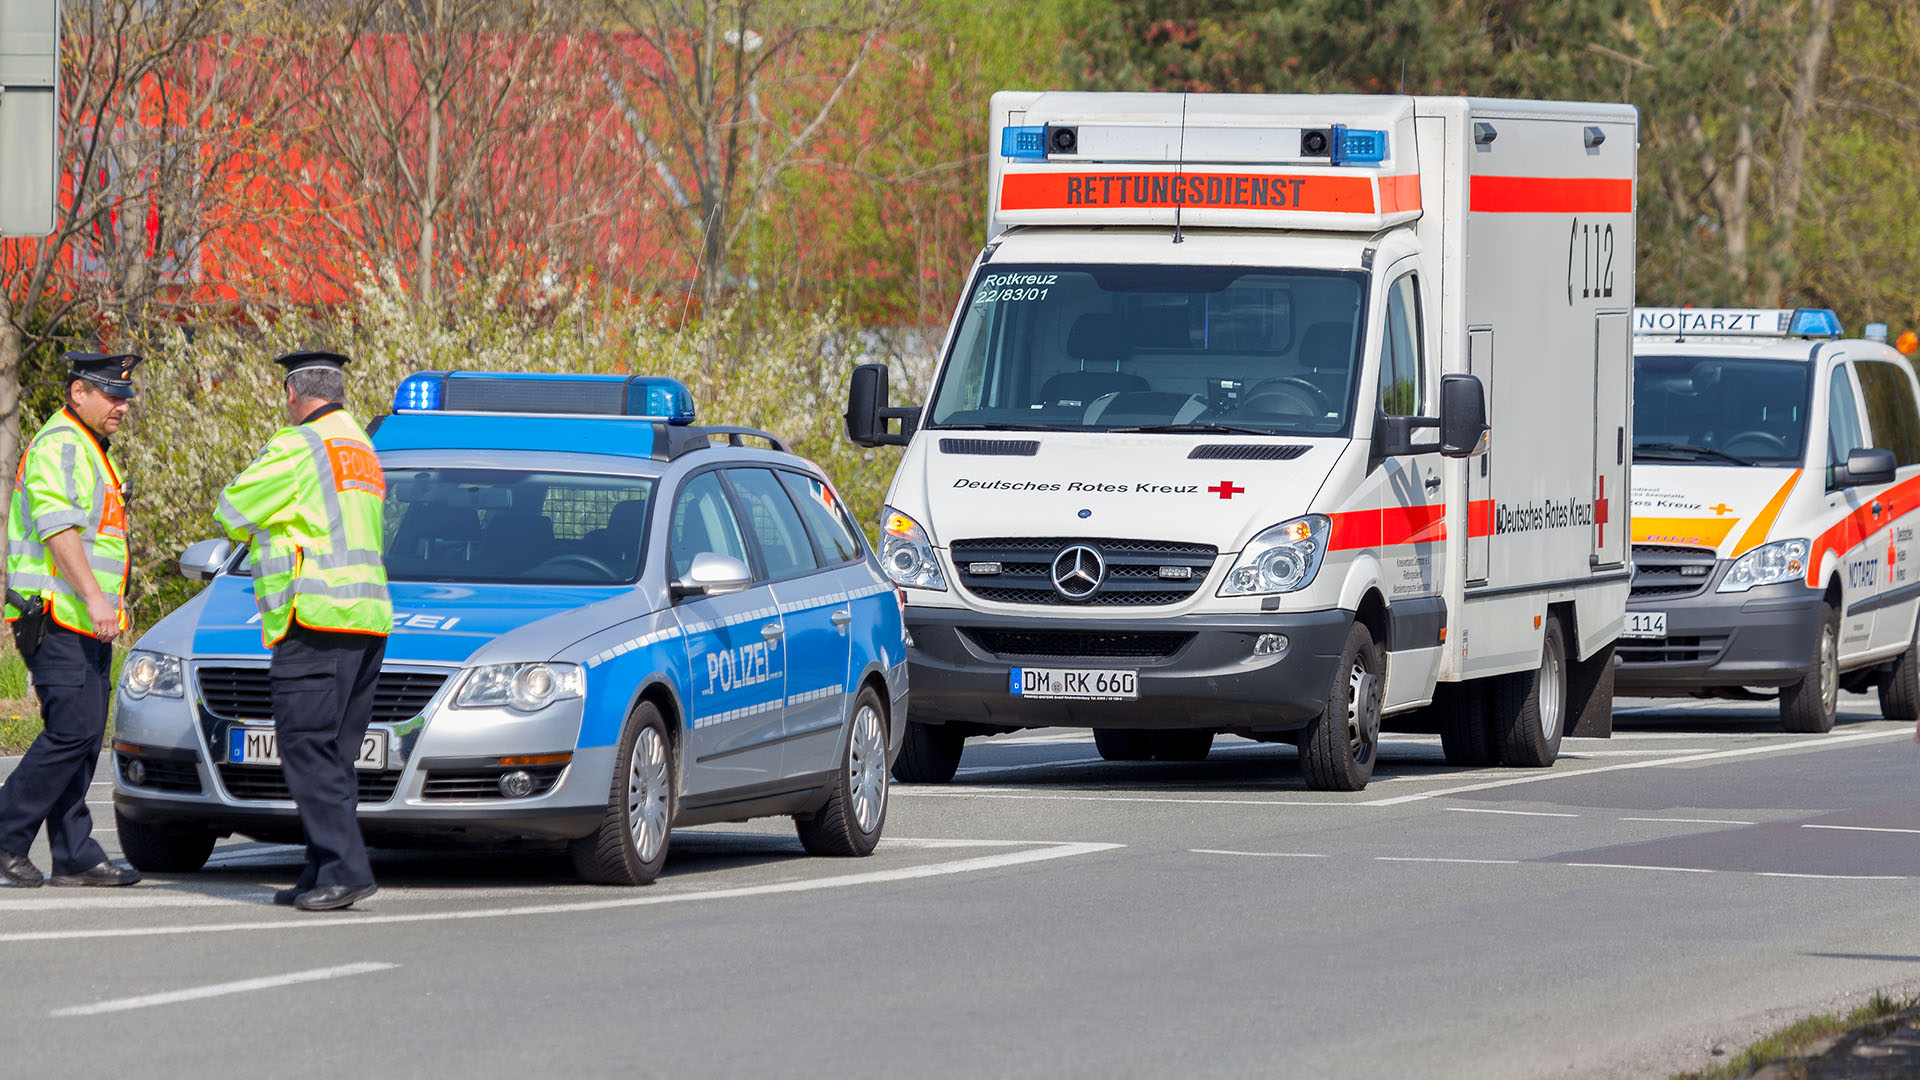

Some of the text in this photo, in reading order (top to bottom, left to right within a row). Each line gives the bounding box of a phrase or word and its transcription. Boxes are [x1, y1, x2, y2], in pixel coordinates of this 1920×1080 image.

[1066, 175, 1306, 207] RETTUNGSDIENST
[1583, 222, 1614, 298] 112
[983, 272, 1059, 287] Rotkreuz
[975, 287, 1049, 304] 22/83/01
[1639, 313, 1761, 331] NOTARZT
[952, 478, 1199, 494] Deutsches Rotes Kreuz
[1501, 496, 1591, 535] Deutsches Rotes Kreuz
[1656, 500, 1702, 510] Kreuz
[1848, 558, 1878, 588] NOTARZT
[1631, 615, 1664, 632] 114
[706, 641, 769, 695] POLIZEI
[1023, 671, 1050, 692] DM
[1064, 672, 1091, 693] RK
[1096, 673, 1135, 694] 660
[247, 734, 281, 759] MV
